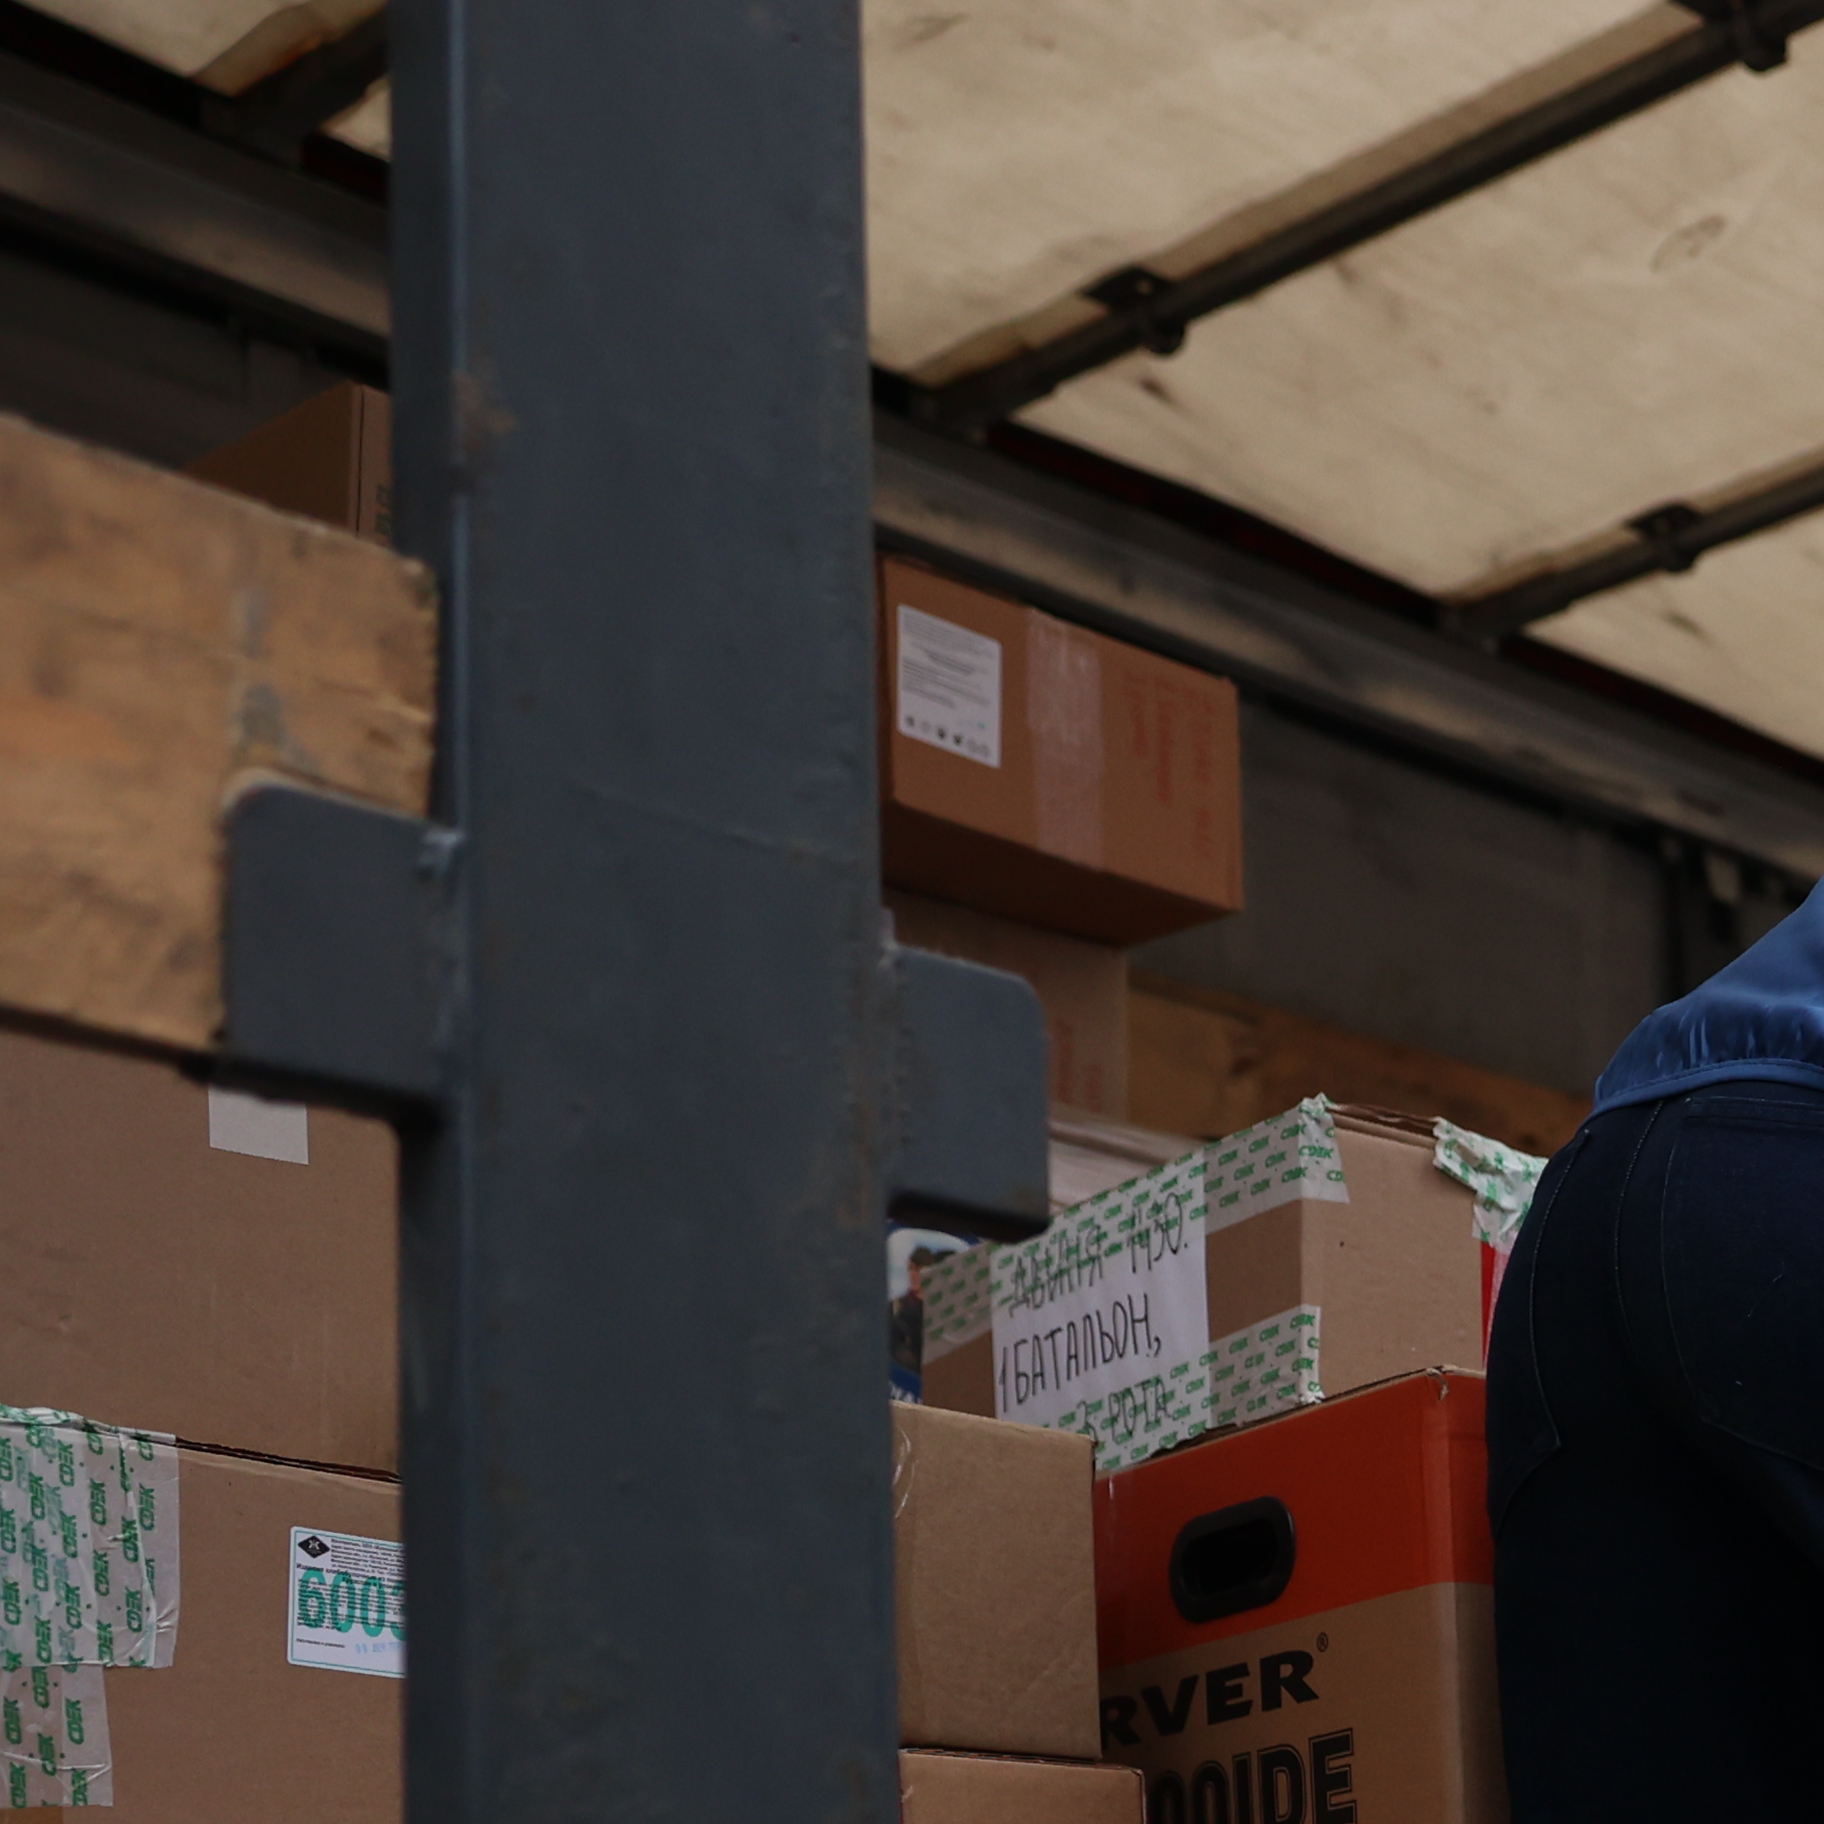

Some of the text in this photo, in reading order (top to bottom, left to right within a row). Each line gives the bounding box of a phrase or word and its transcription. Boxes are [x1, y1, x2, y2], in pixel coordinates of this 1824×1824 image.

[58, 1439, 76, 1487] CDEK
[28, 1472, 46, 1521] CDEK
[90, 1477, 107, 1526] CDEK
[139, 1483, 156, 1531] CDEK
[61, 1511, 79, 1559] CDEK
[94, 1550, 111, 1597] CDEK
[4, 1579, 21, 1626] CDEK
[64, 1583, 82, 1630] CDEK
[125, 1586, 143, 1633] CDEK
[34, 1616, 52, 1664] CDEK
[4, 1698, 22, 1745] CDEK
[65, 1698, 84, 1745] CDEK
[1100, 1649, 1319, 1750] RVER
